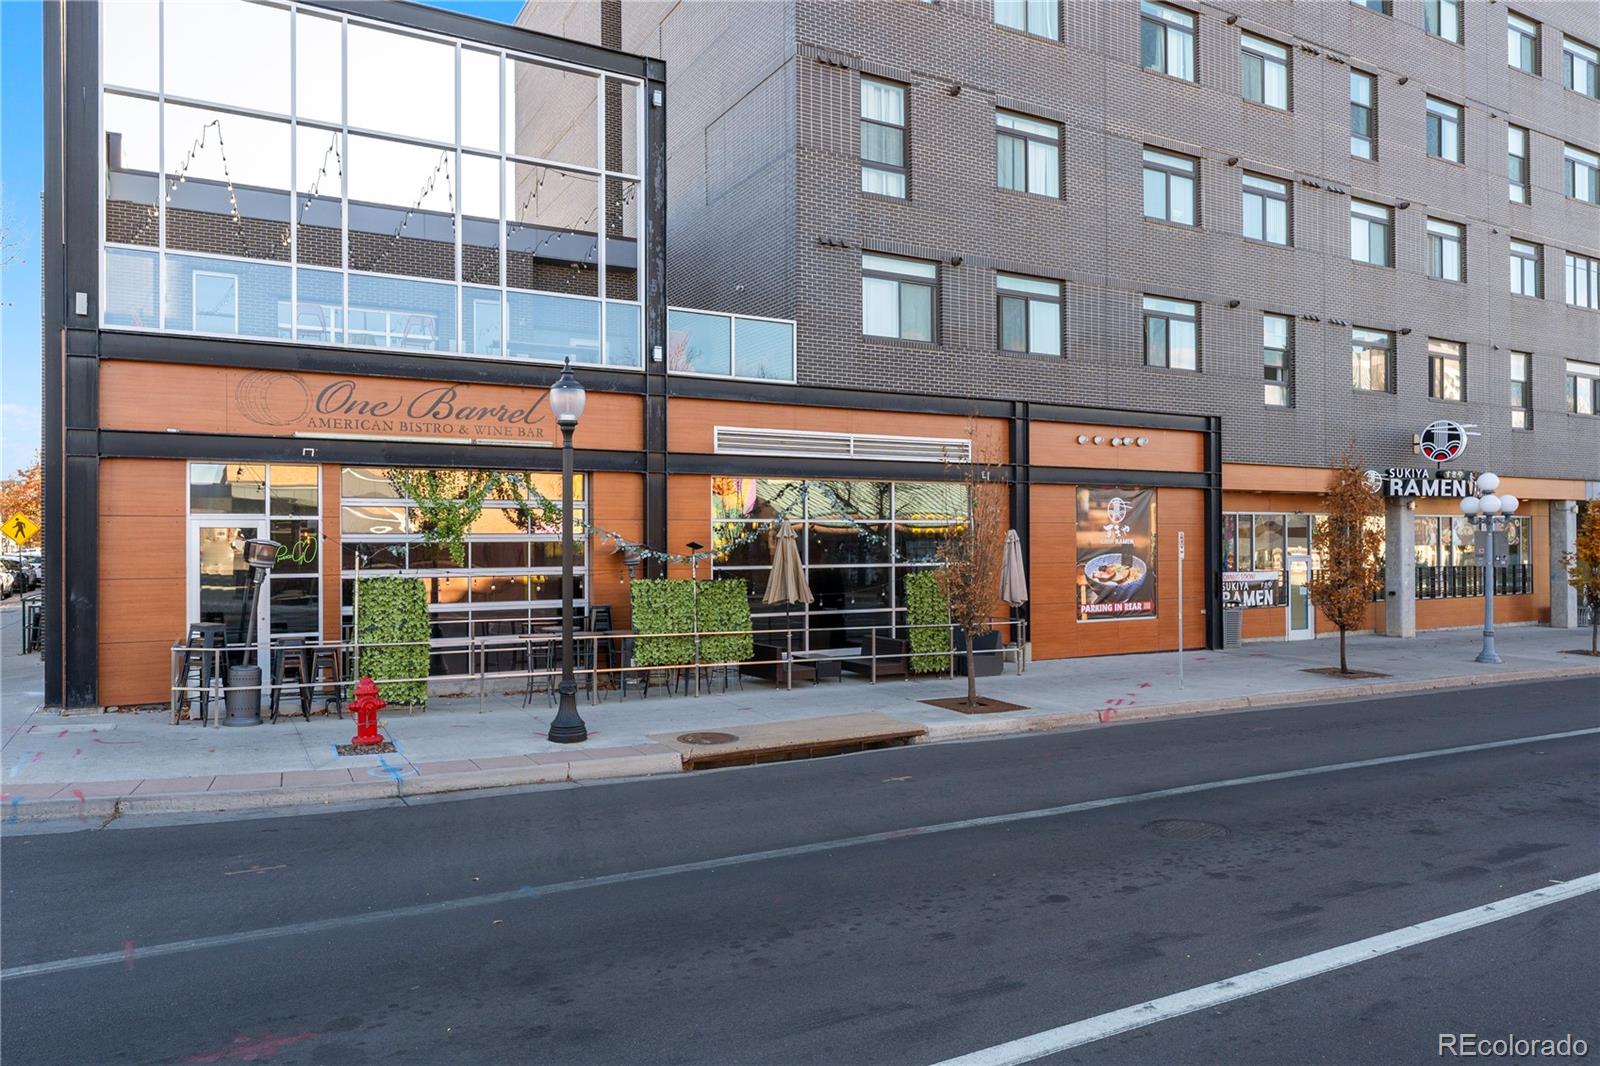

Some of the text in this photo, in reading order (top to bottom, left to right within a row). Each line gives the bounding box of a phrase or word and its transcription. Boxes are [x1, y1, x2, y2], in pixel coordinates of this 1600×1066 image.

[315, 380, 550, 425] One Barrel
[306, 417, 545, 439] AMERICAN BISTRO & WINE BAR
[1389, 468, 1430, 479] SUKIYA
[1389, 479, 1467, 497] RAMEN
[1222, 581, 1249, 591] SUKIYA
[1080, 602, 1142, 613] PARKING IN REAR
[1222, 589, 1274, 608] RAMEN
